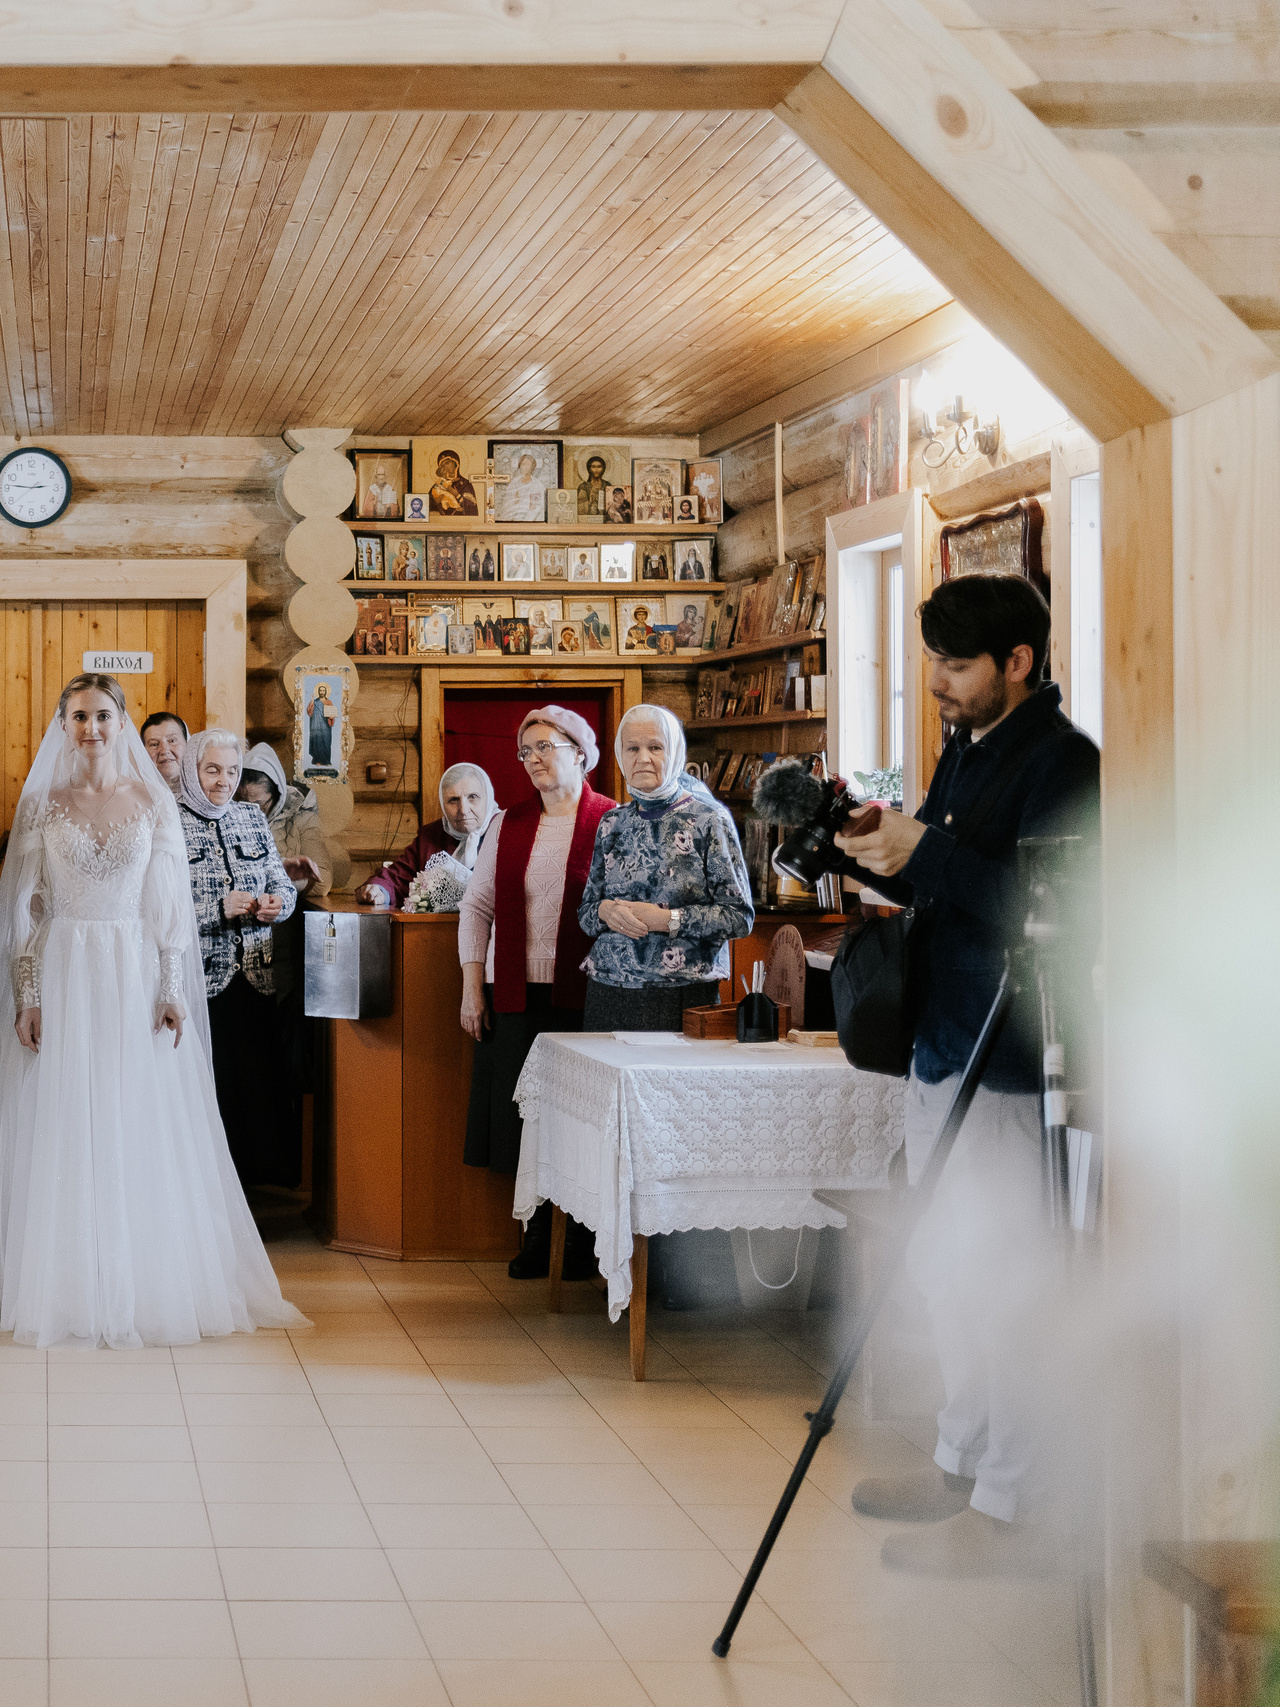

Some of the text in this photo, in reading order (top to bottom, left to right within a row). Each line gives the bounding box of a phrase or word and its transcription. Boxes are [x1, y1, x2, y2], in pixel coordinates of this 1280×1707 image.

[27, 460, 36, 468] 12
[7, 473, 17, 482] 10
[49, 470, 55, 479] 2
[4, 484, 10, 492] 9
[53, 484, 59, 492] 3
[8, 496, 14, 505] 8
[49, 496, 55, 504] 4
[18, 504, 24, 513] 7
[28, 508, 35, 516] 6
[40, 505, 46, 513] 5
[93, 656, 143, 670] ВЫХОД
